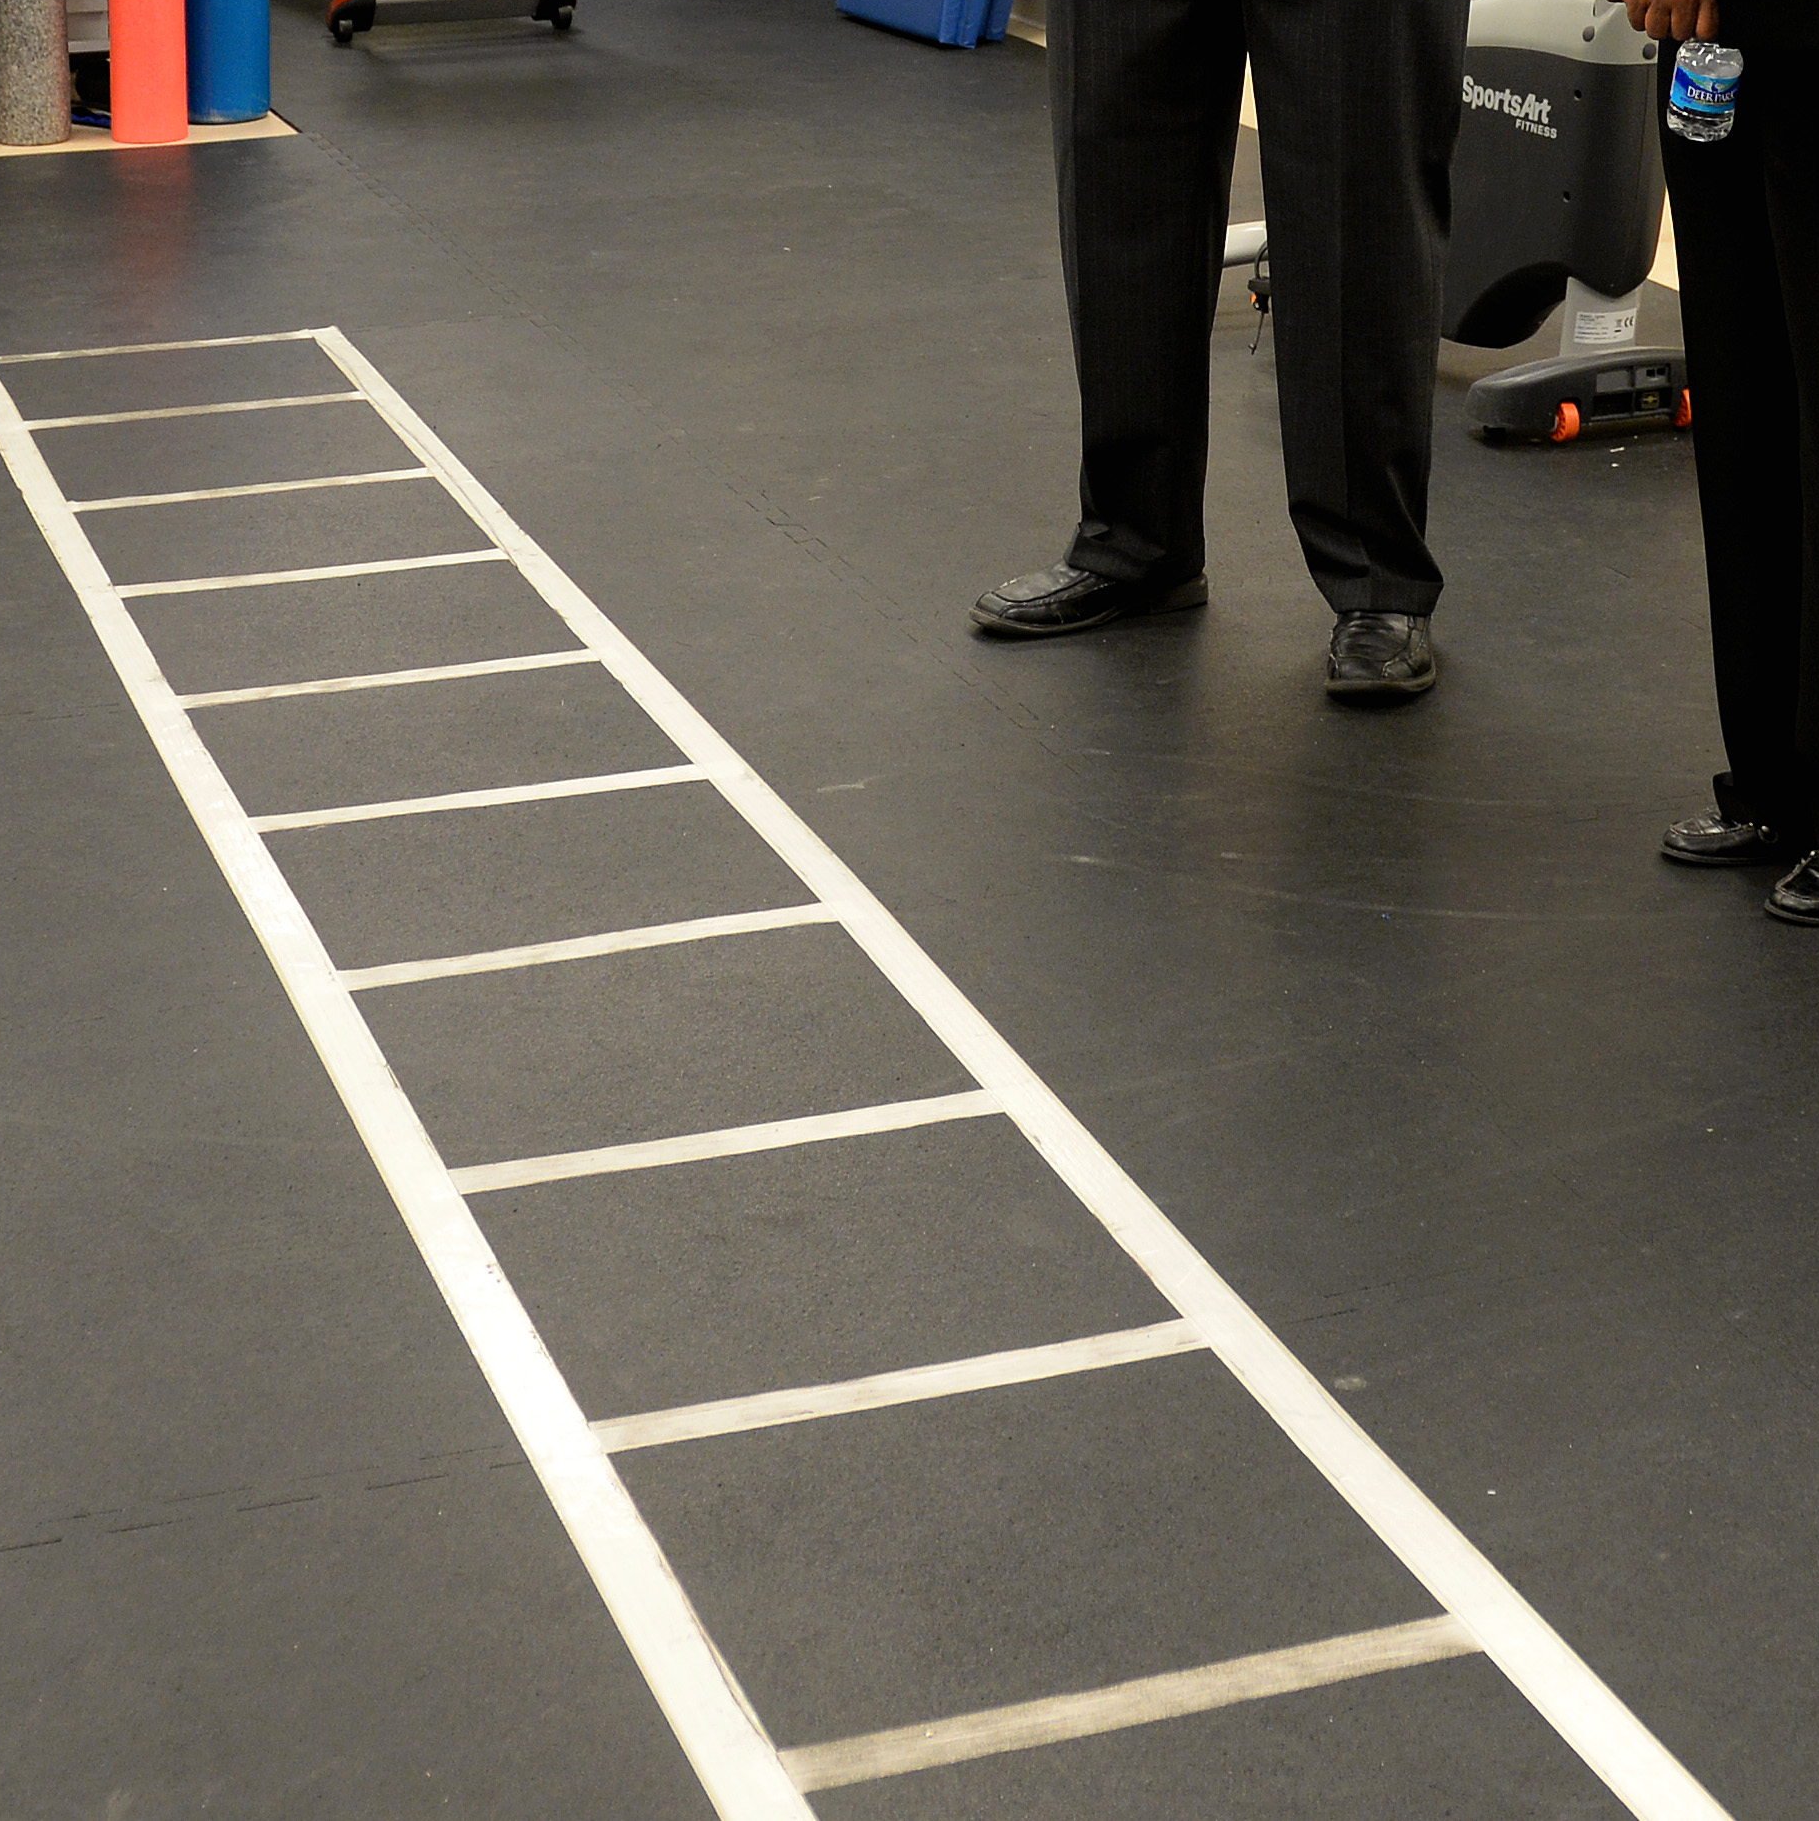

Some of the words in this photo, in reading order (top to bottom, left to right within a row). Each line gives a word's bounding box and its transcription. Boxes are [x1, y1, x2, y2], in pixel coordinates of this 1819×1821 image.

[1462, 74, 1552, 125] SportsArt
[1687, 85, 1713, 102] DEER
[1515, 118, 1558, 139] FITNESS
